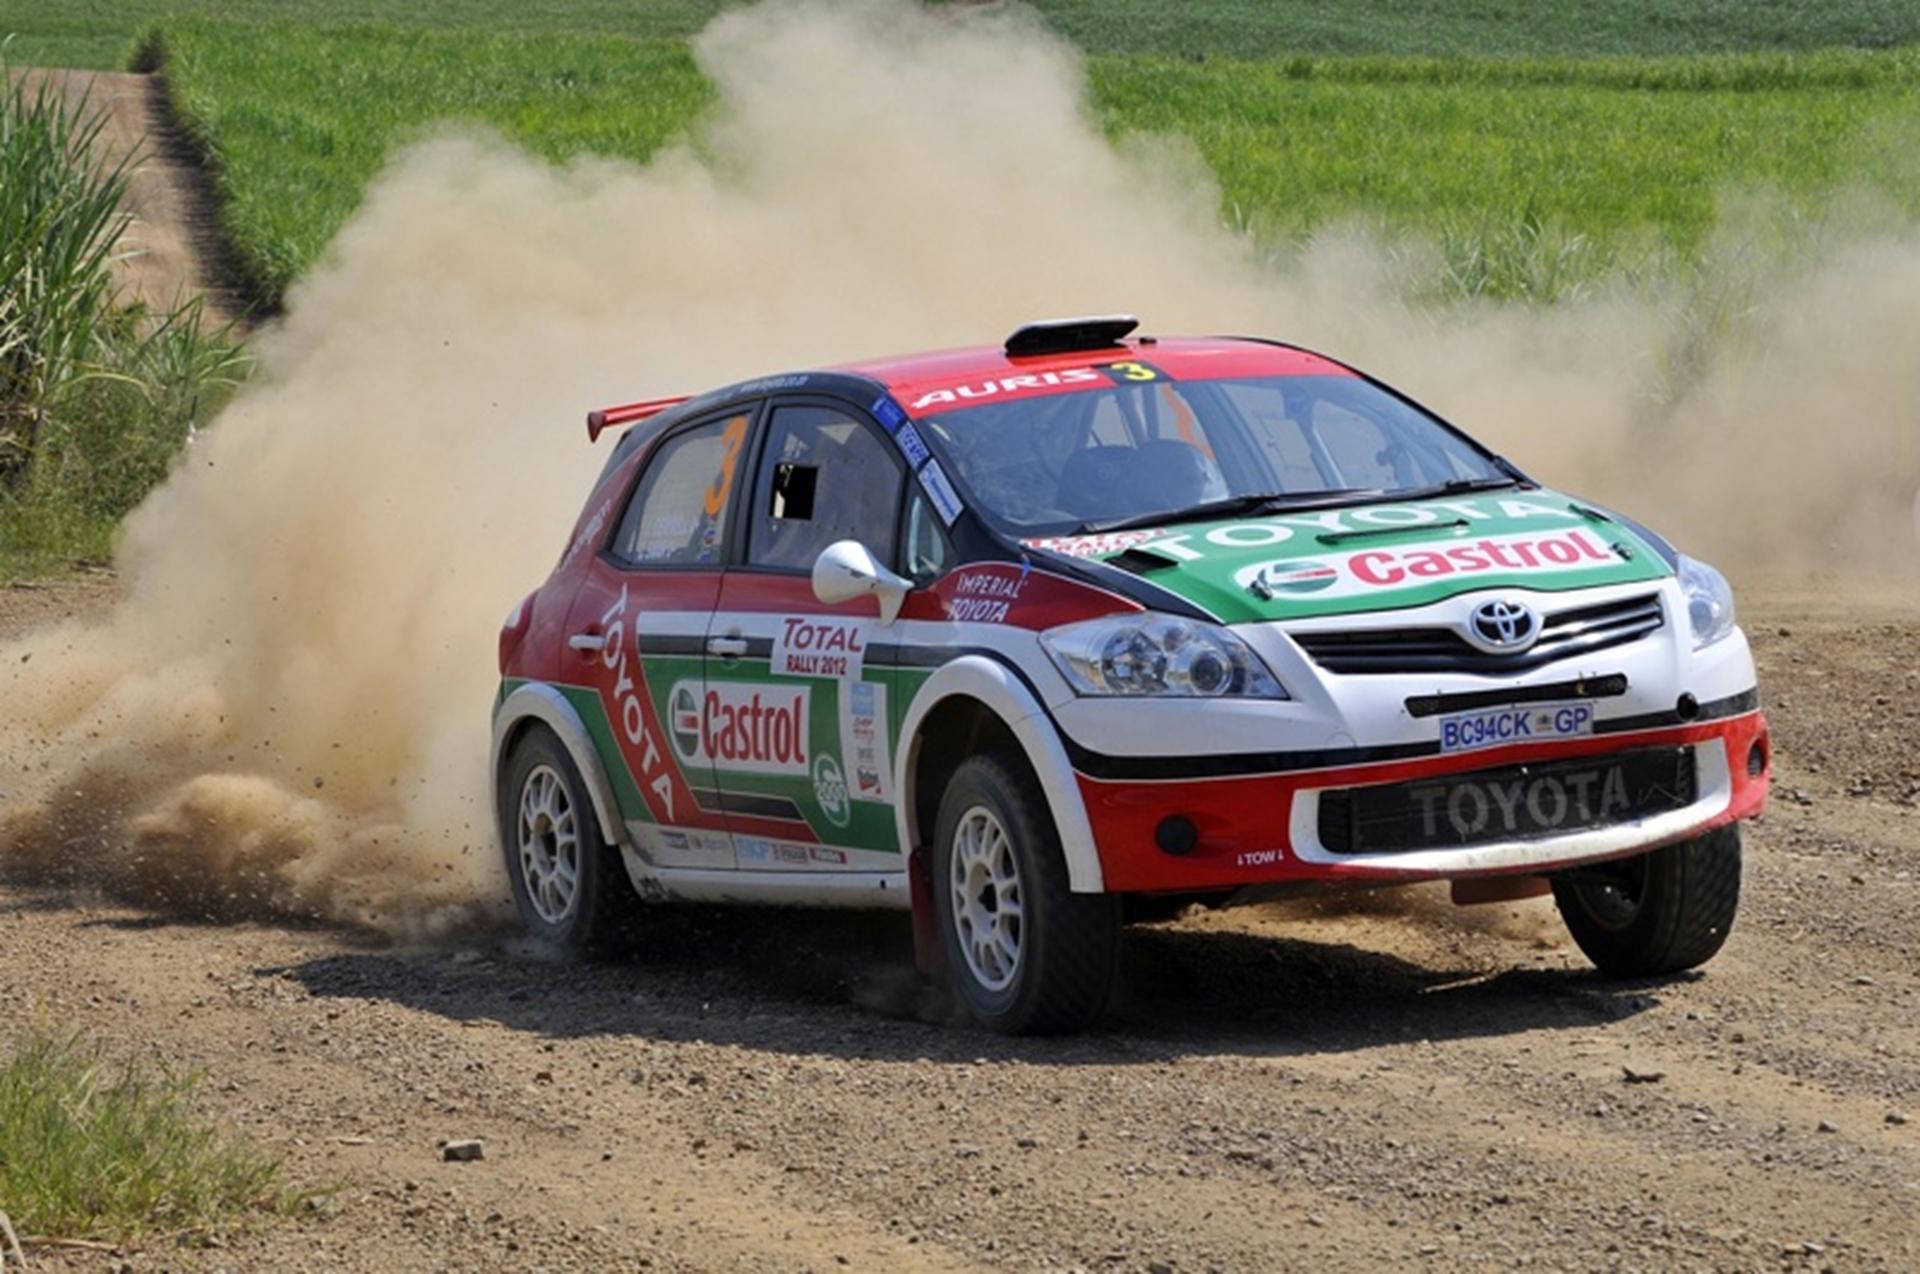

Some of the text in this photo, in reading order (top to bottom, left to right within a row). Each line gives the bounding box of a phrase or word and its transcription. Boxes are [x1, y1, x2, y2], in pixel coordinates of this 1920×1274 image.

[911, 366, 1099, 409] AURIS
[1111, 362, 1157, 381] 3
[705, 415, 748, 515] 3
[1133, 499, 1588, 562] TOYOTA
[1347, 531, 1610, 586] Castrol
[956, 573, 1020, 598] IMPERIAL
[950, 598, 1011, 622] TOYOTA
[784, 618, 862, 652] TOTAL
[786, 654, 847, 676] RALLY 2012
[602, 582, 674, 823] TOYOTA
[702, 690, 804, 764] Castrol
[1444, 707, 1589, 748] BC94CK GP
[1409, 765, 1631, 840] TOYOTA
[1244, 850, 1276, 866] TOW
